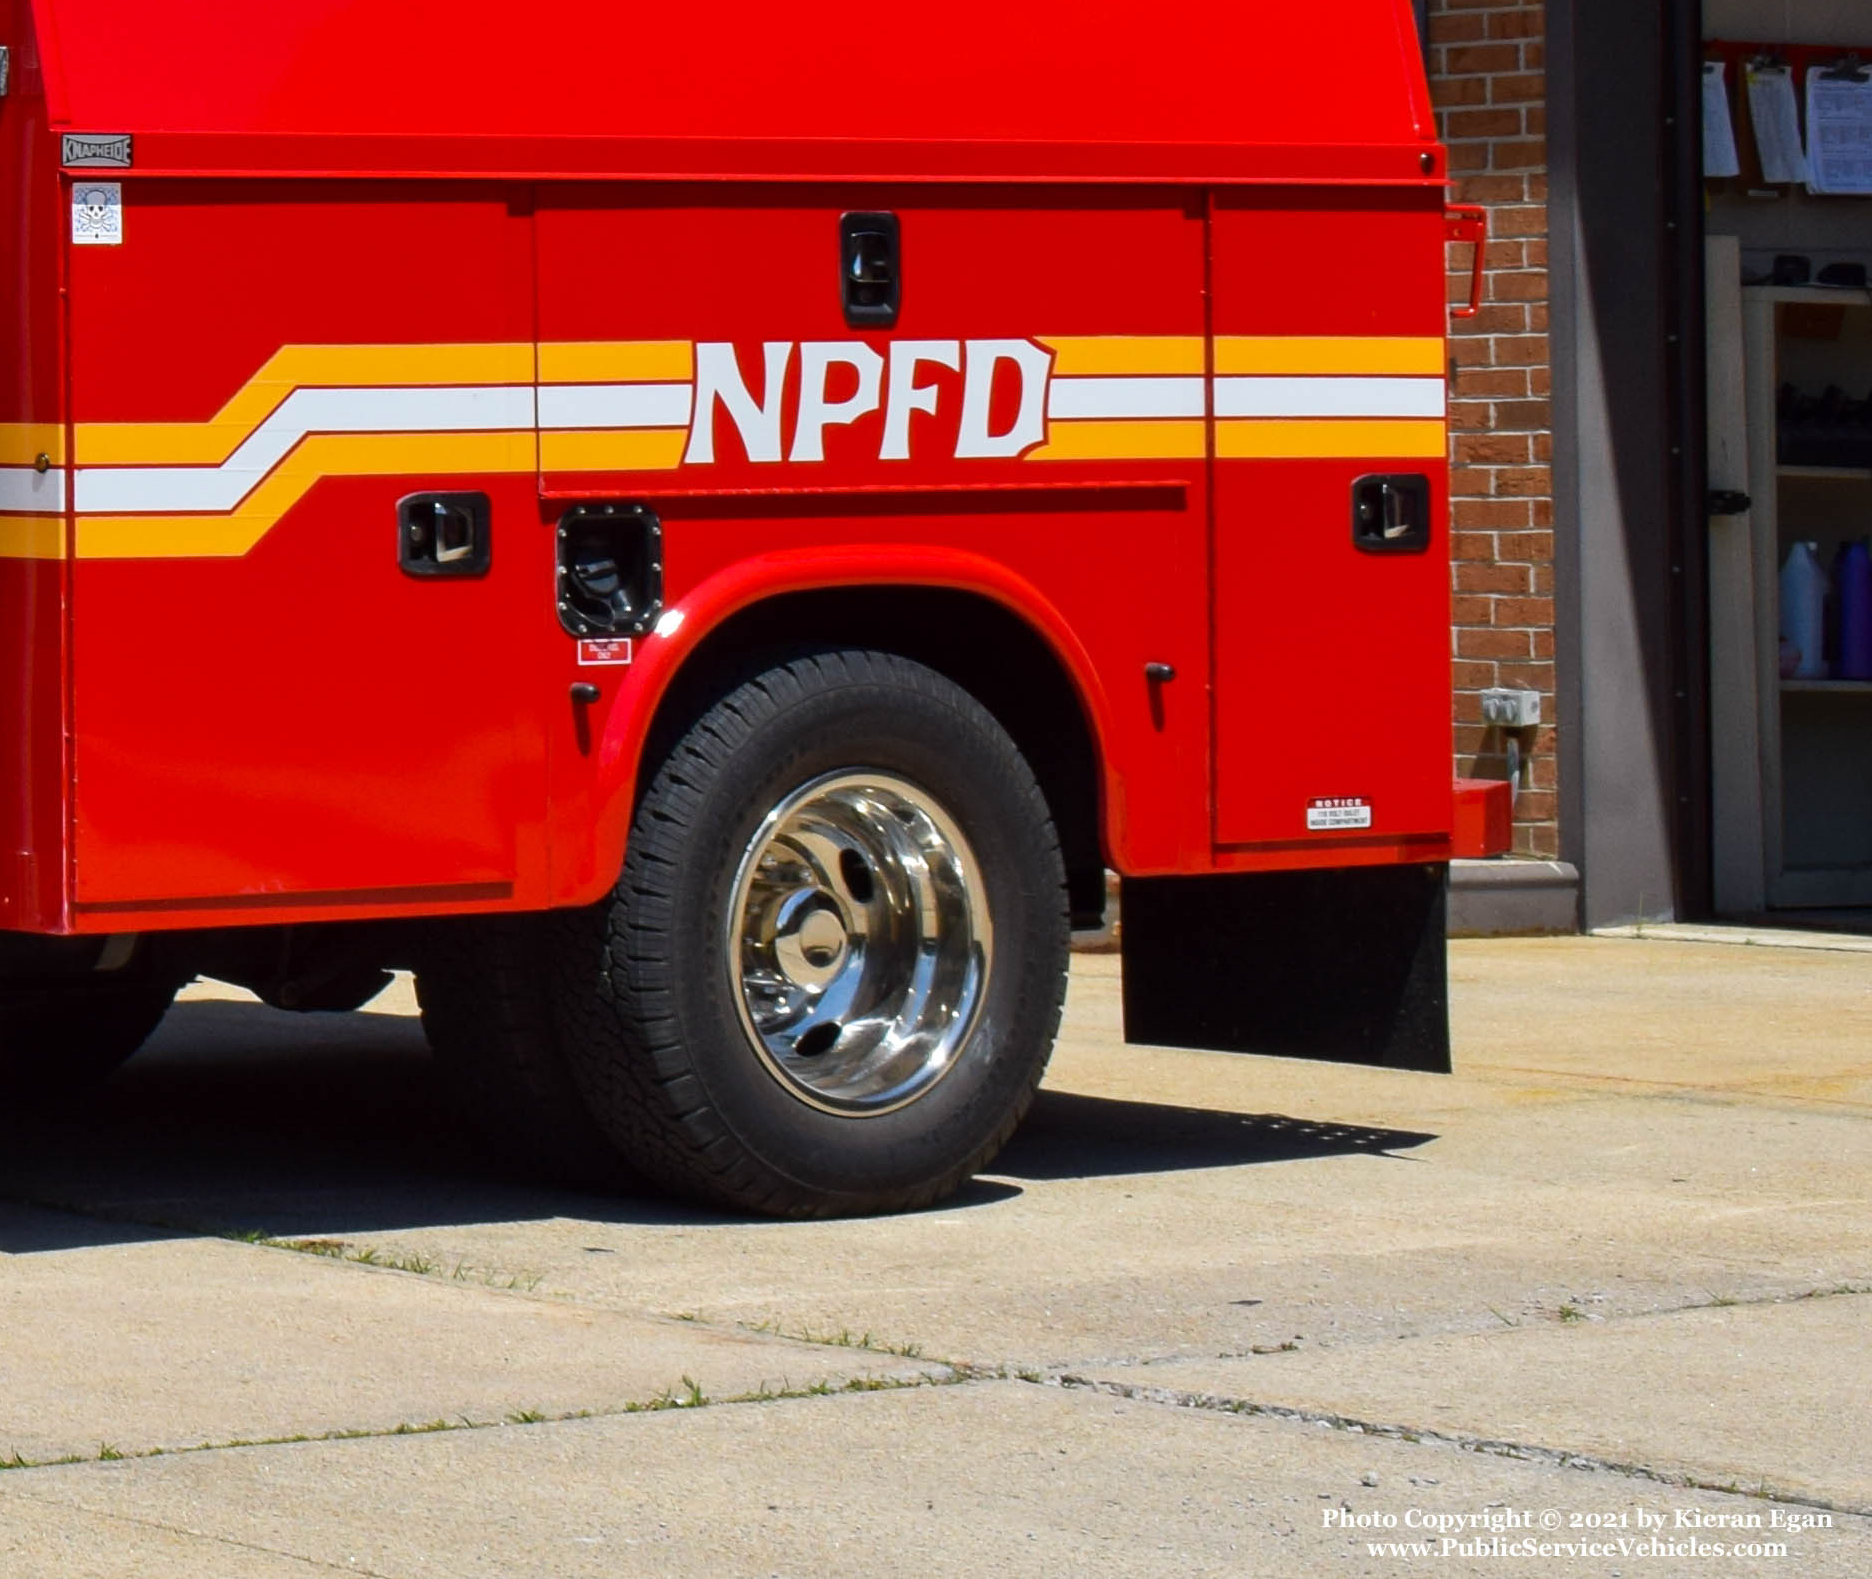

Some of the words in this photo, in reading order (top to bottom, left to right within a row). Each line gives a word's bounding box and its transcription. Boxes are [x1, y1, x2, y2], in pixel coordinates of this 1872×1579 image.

[64, 137, 131, 164] KNAPHEIDE
[684, 339, 1052, 464] NPFD
[1315, 798, 1362, 808] NOTICE
